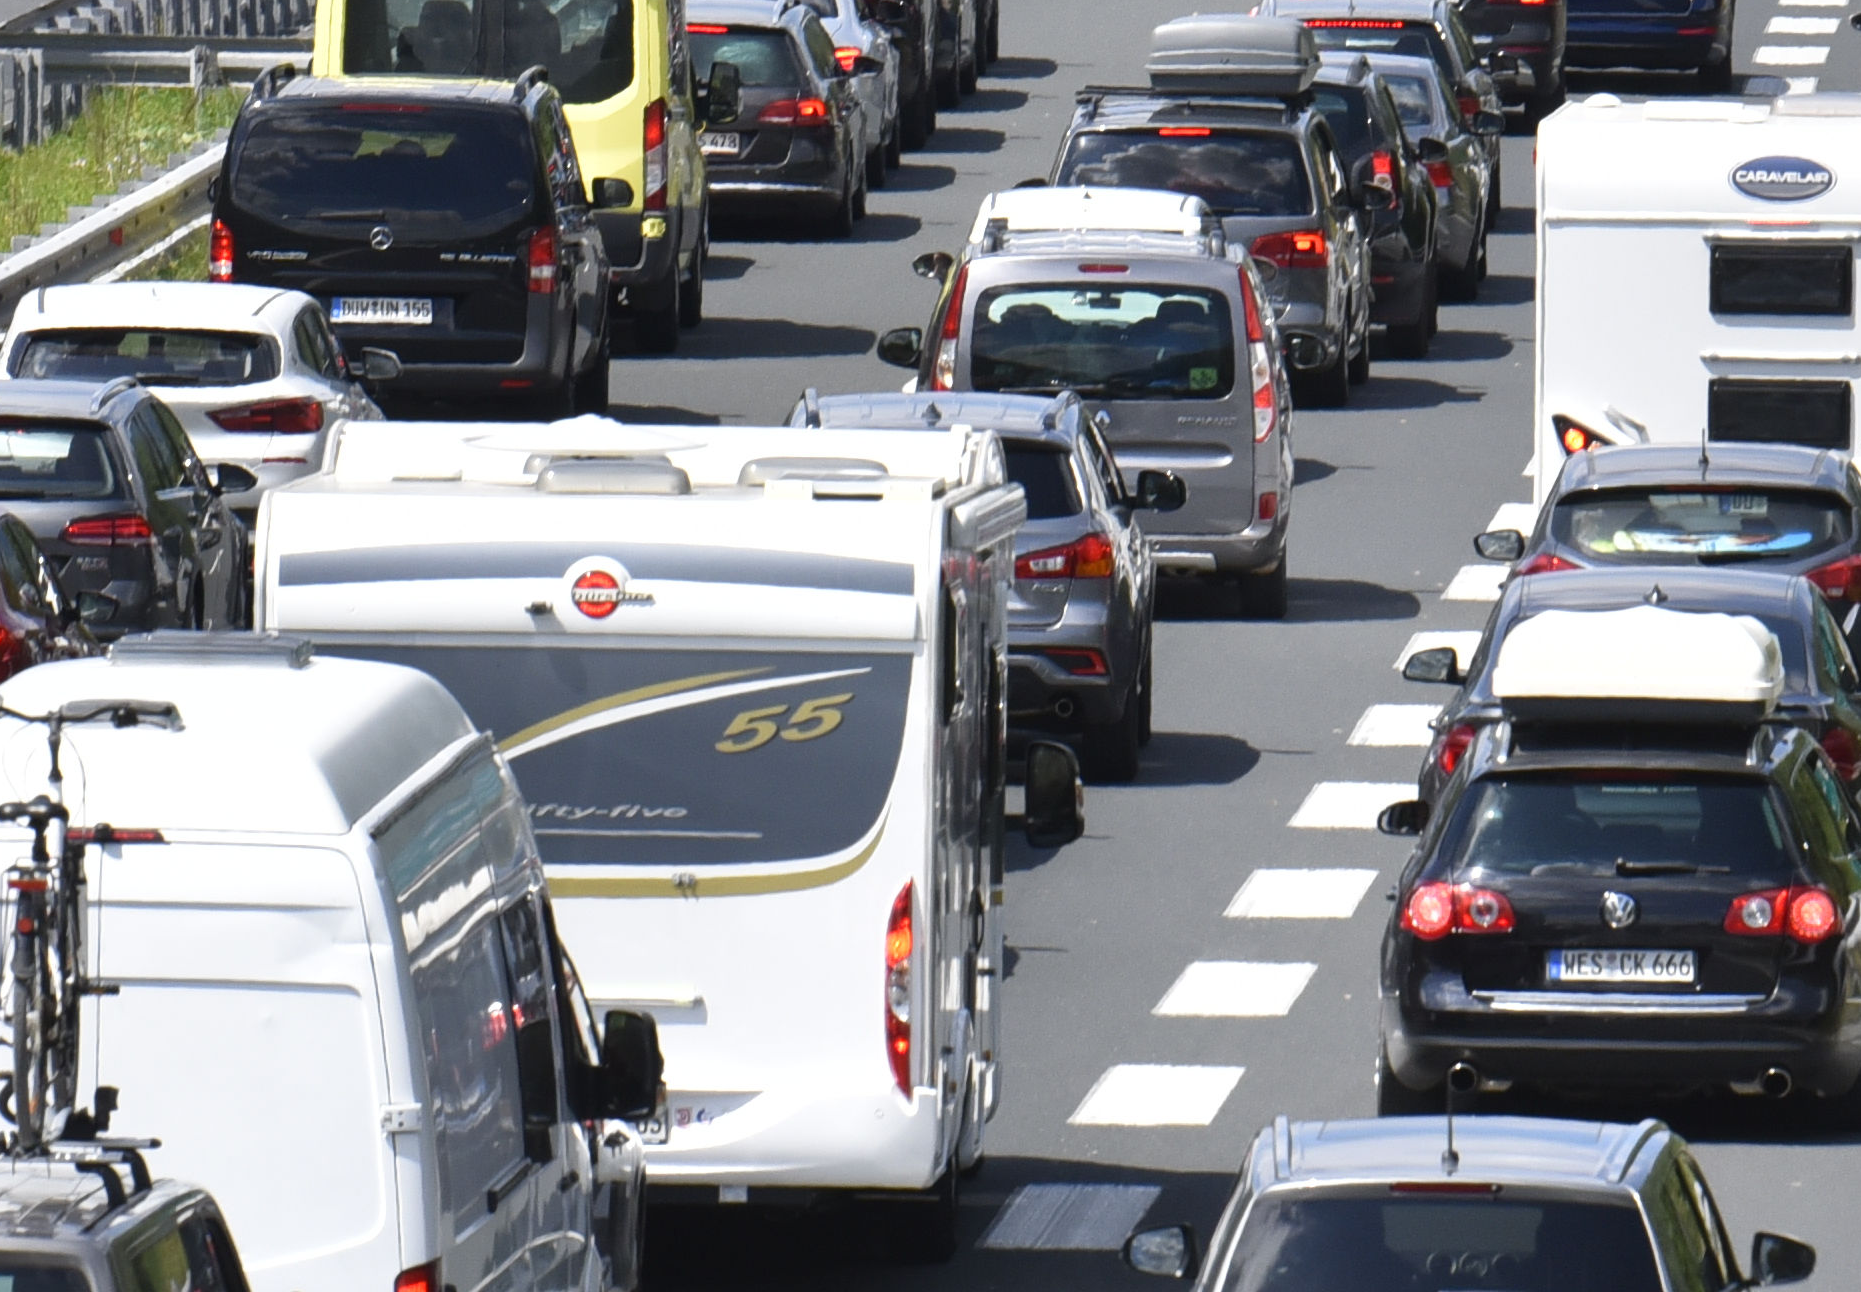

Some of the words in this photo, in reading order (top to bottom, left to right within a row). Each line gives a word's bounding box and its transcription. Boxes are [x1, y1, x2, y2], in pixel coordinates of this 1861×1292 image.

[1735, 170, 1830, 184] CARAVELAIR
[403, 299, 431, 318] 155
[714, 692, 855, 755] 55
[528, 802, 689, 823] ifty-five
[1563, 952, 1604, 976] WES
[1619, 952, 1644, 976] CK
[1652, 952, 1691, 976] 666
